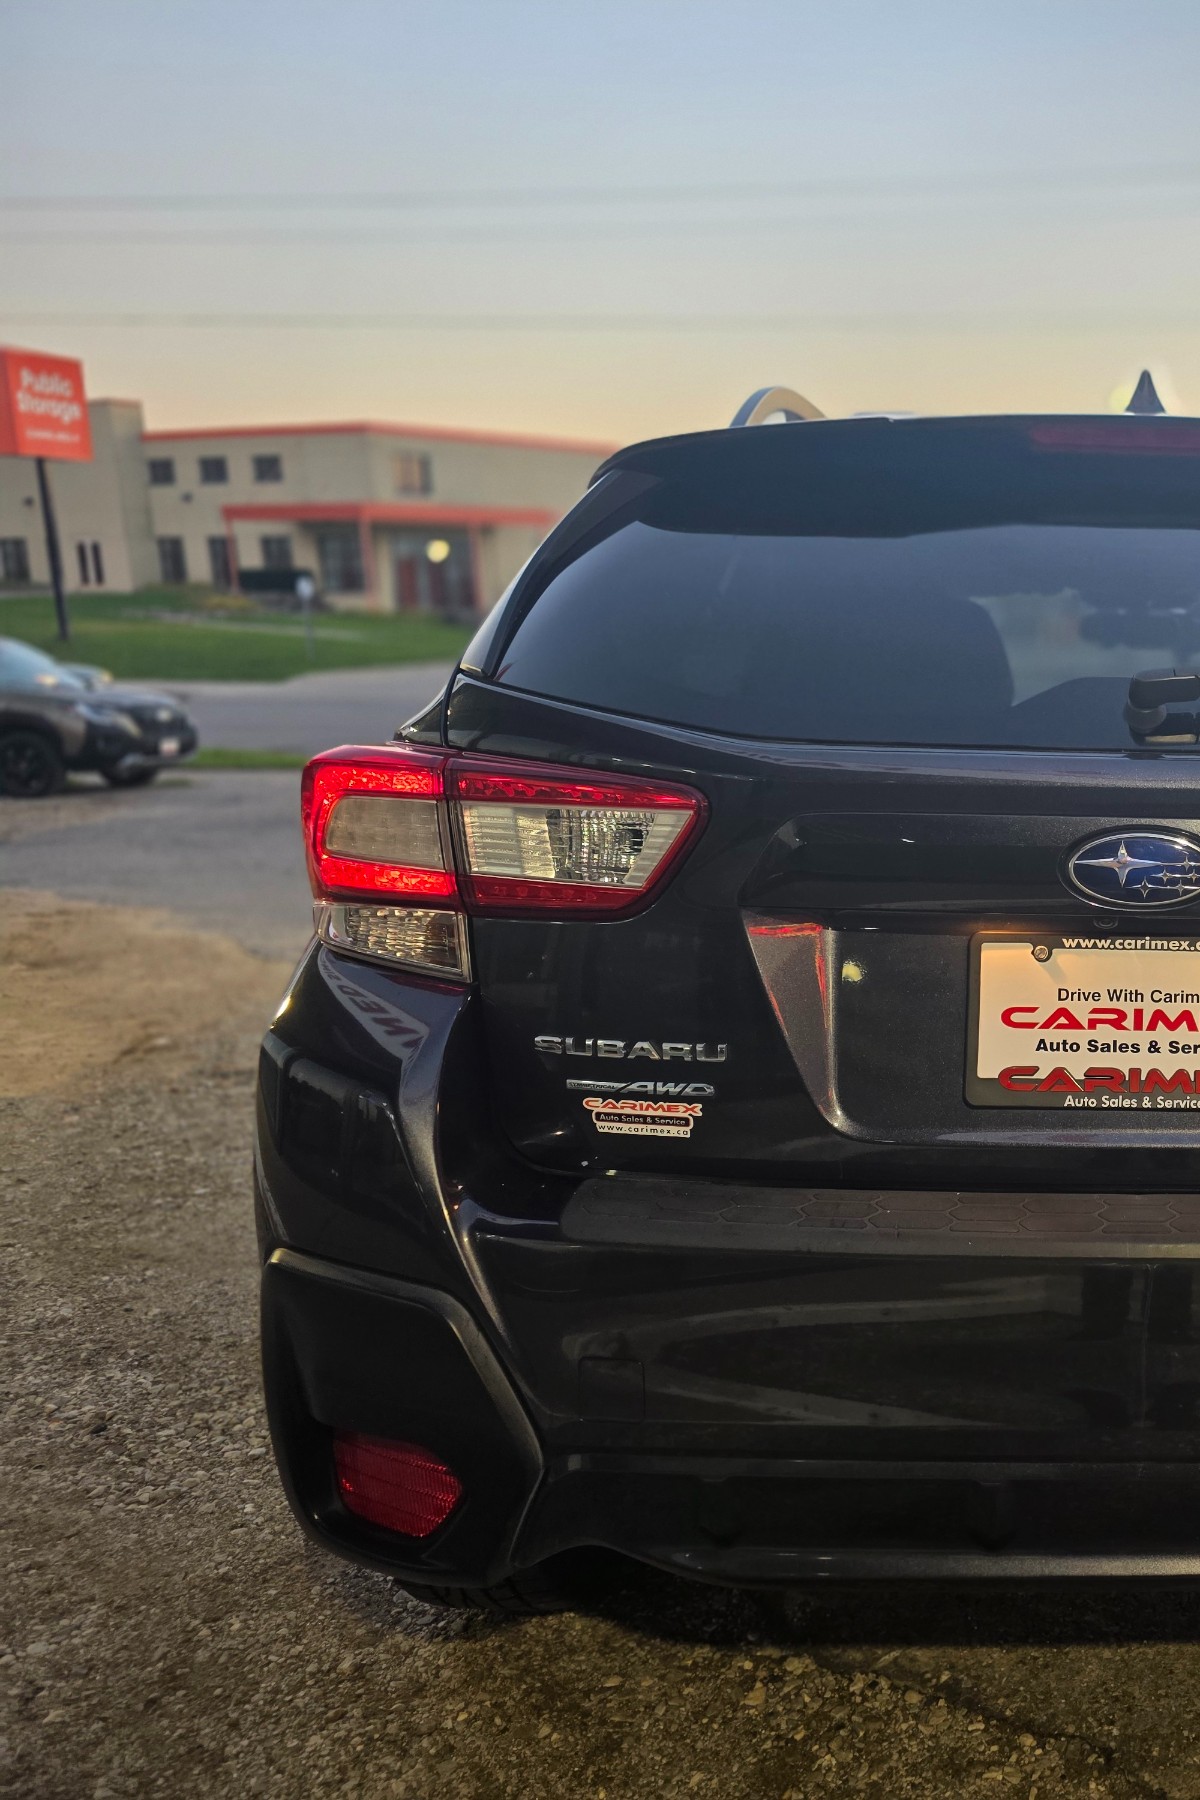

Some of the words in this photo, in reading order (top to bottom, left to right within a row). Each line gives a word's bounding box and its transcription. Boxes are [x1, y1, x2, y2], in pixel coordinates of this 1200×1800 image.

[1057, 988, 1101, 1003] Drive
[1107, 989, 1145, 1004] With
[534, 1035, 727, 1062] SUBARU
[1035, 1038, 1081, 1053] Auto
[1087, 1039, 1141, 1054] Sales
[1147, 1041, 1162, 1054] &
[620, 1081, 715, 1097] AWD
[584, 1099, 701, 1115] CARIMEX
[1064, 1095, 1097, 1108] Auto
[1101, 1096, 1139, 1109] Sales
[1142, 1097, 1152, 1109] &
[600, 1114, 620, 1122] Auto
[621, 1115, 644, 1123] Sales
[646, 1116, 653, 1124] &
[654, 1117, 686, 1126] Service
[598, 1123, 688, 1136] www.carimex.ca
